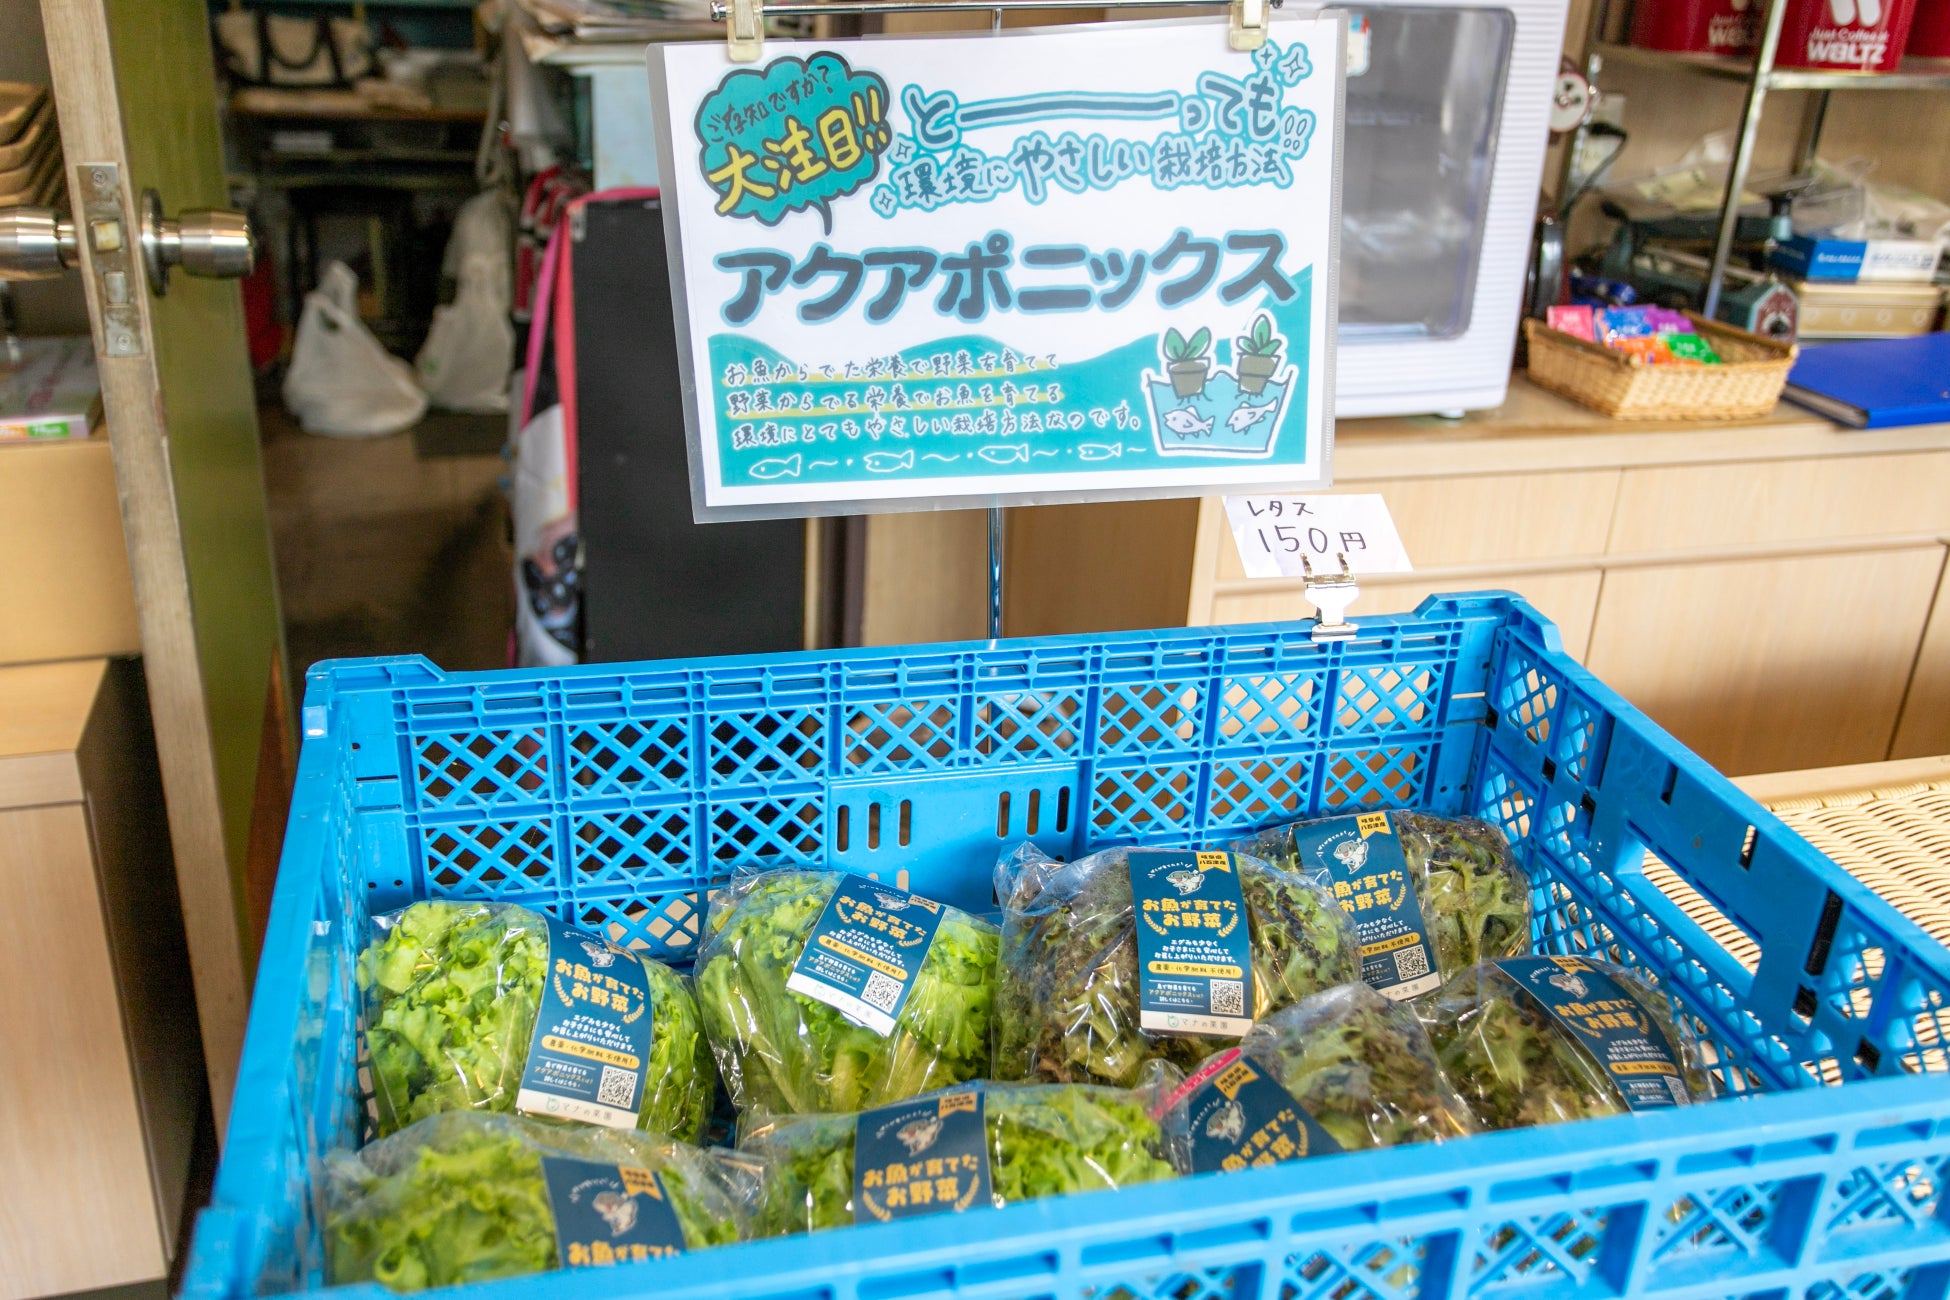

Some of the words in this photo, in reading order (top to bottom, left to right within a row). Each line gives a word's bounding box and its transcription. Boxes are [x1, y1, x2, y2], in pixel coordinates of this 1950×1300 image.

[707, 65, 834, 142] ご存知ですか?
[708, 86, 888, 214] 大注目!!
[716, 231, 1298, 323] アクアポニックス
[727, 351, 1060, 386] お魚からでた栄養で野菜を育てて
[727, 384, 1061, 416] 野菜からでる栄養でお魚を育てる
[732, 403, 1140, 449] 環境にとてもやさしい栽培方法なのです。
[1247, 500, 1314, 517] レタス
[1258, 525, 1366, 553] 150円
[839, 895, 928, 937] お魚が育てた
[1142, 897, 1237, 912] お魚が育てた
[1339, 888, 1392, 913] お野菜
[852, 911, 908, 940] お野菜
[1163, 912, 1222, 928] お野菜
[1356, 916, 1392, 930] グみも少なく
[1361, 926, 1412, 943] がりいただけます。
[555, 958, 645, 1000] お魚が育てた
[571, 982, 630, 1013] お野菜
[1554, 998, 1636, 1017] お魚が育てた
[1585, 1011, 1638, 1030] お野菜
[1221, 1107, 1296, 1172] 魚が育てた
[1251, 1133, 1296, 1167] 野菜
[863, 1153, 979, 1188] お魚が育てた
[885, 1176, 960, 1207] お野菜
